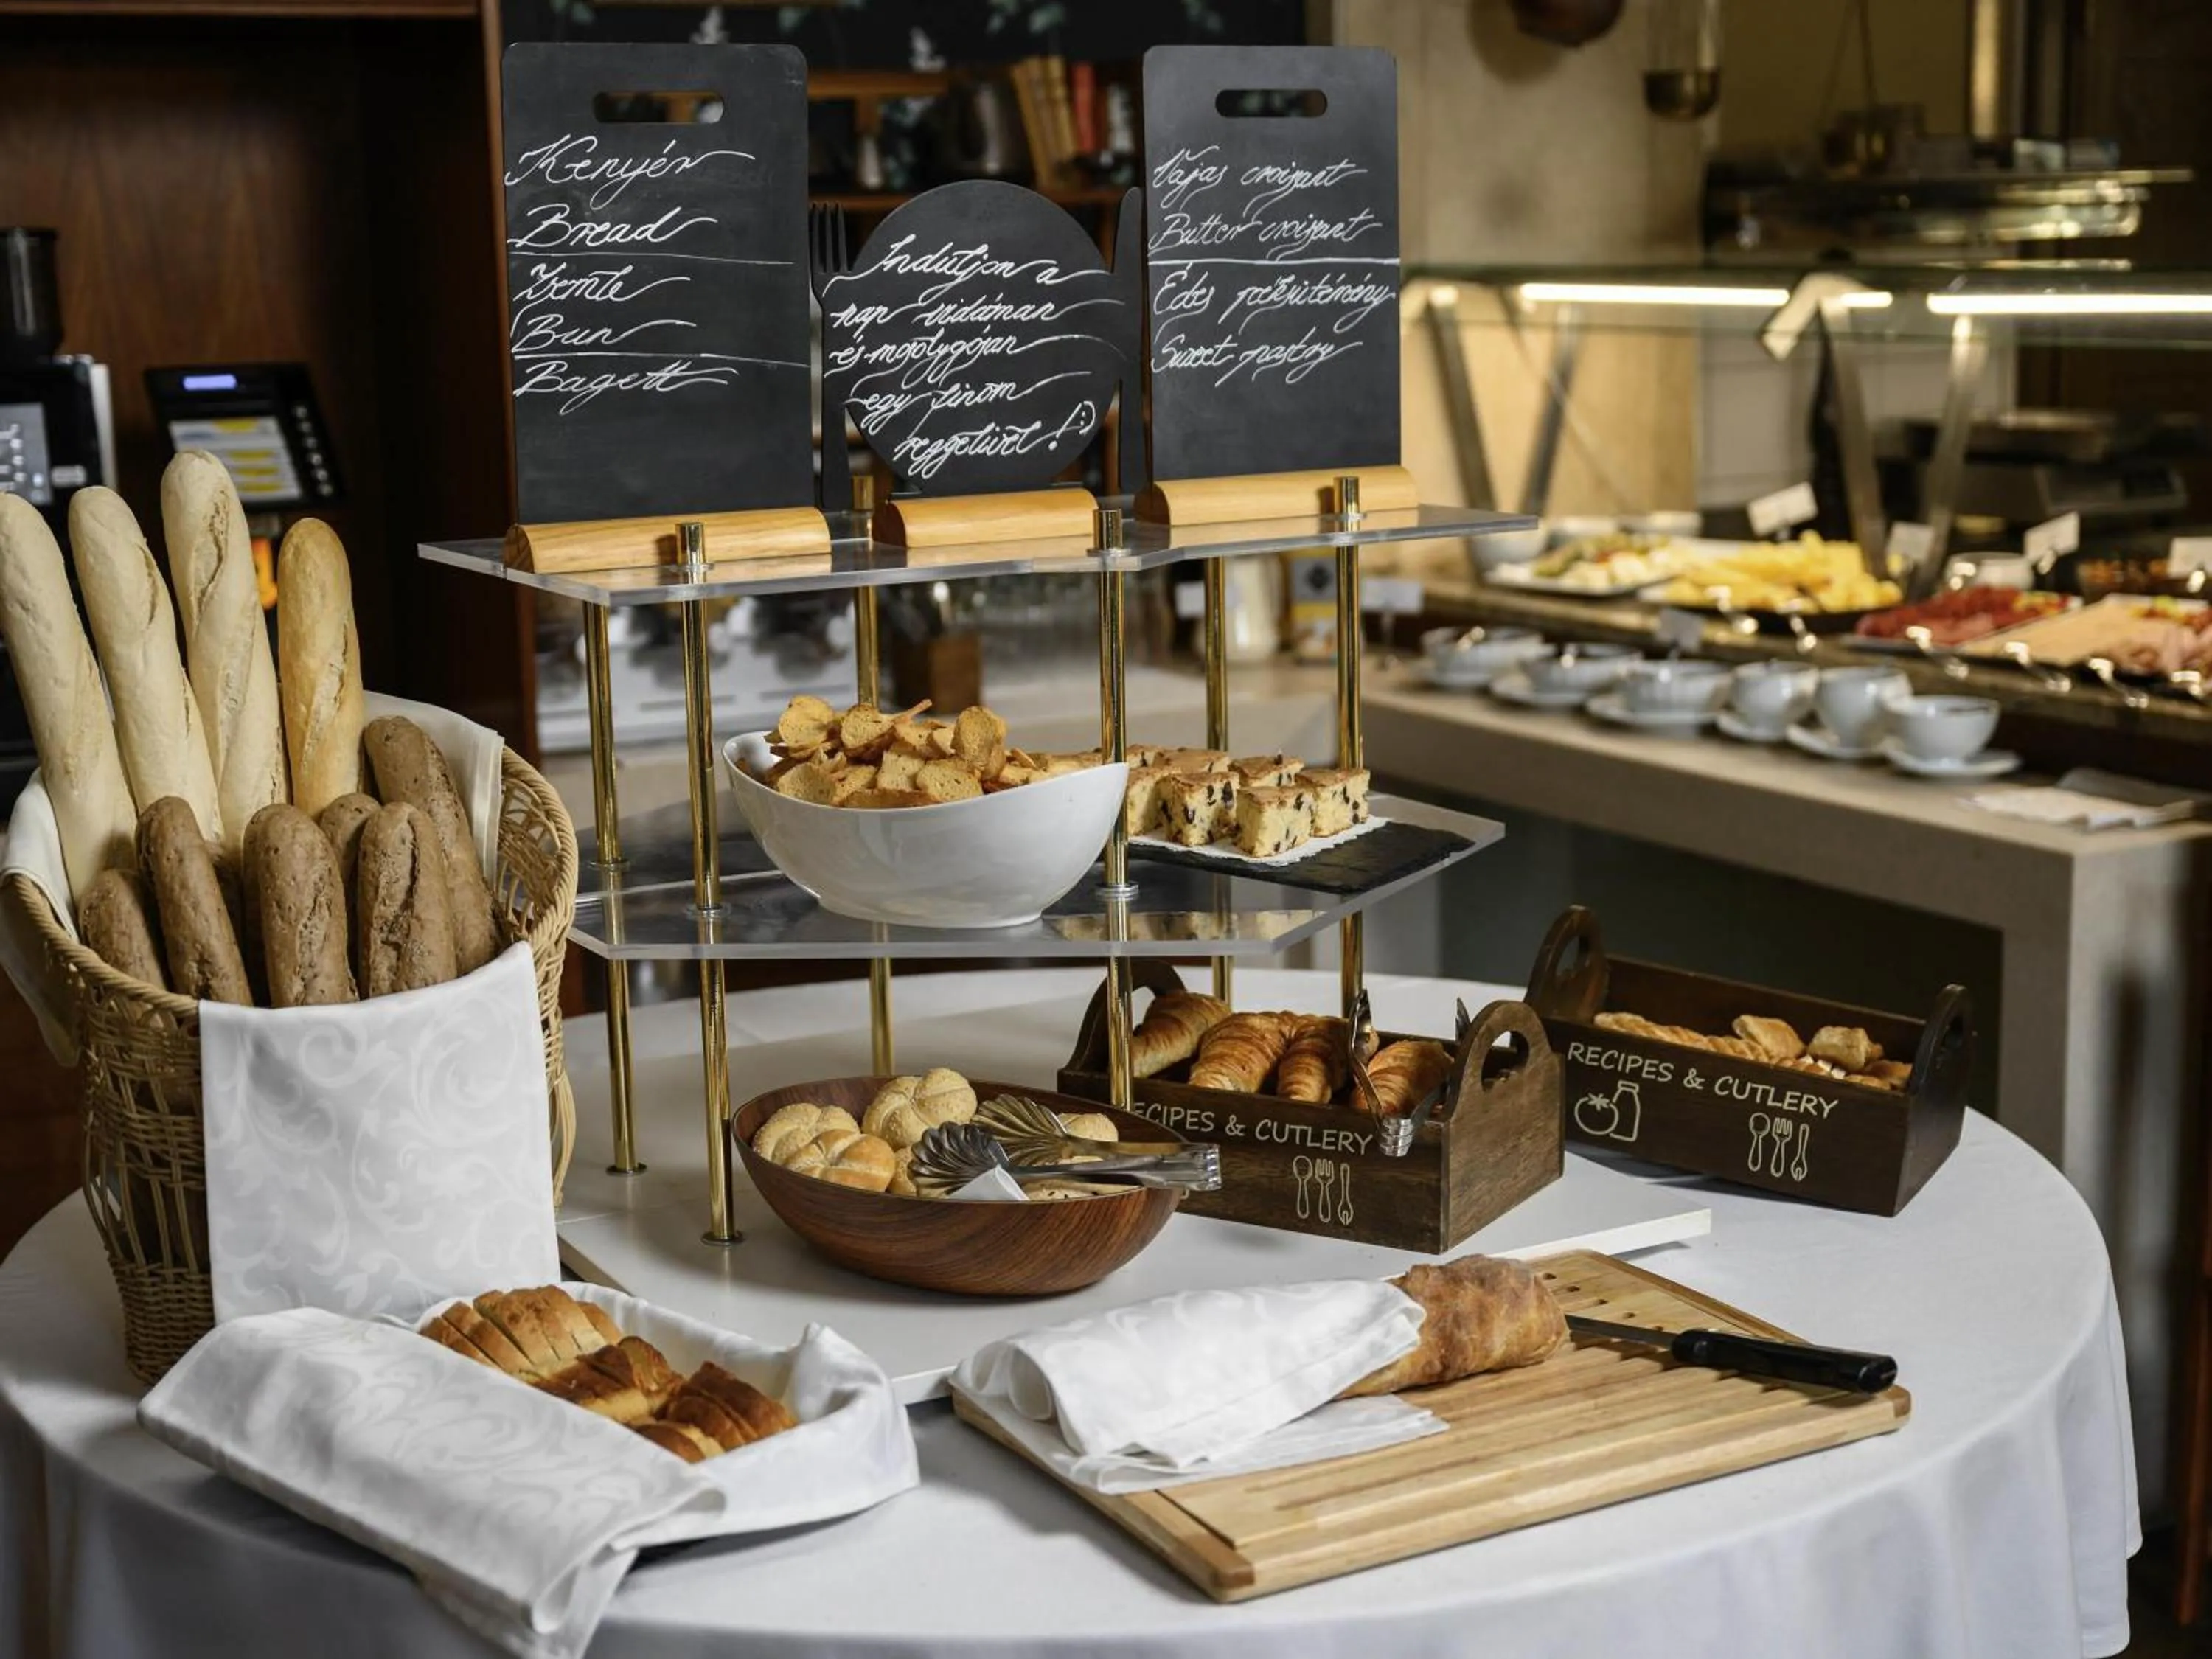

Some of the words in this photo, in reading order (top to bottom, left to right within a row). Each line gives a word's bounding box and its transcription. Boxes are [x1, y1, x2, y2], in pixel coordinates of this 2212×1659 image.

[1152, 145, 1228, 210] Vajas
[507, 204, 719, 248] Bread
[1147, 213, 1263, 257] Butter
[511, 313, 697, 353] Bun
[1568, 1042, 1674, 1083] RECIPES
[1683, 1068, 1704, 1091] &
[1714, 1076, 1838, 1119] CUTLERY
[1133, 1102, 1215, 1133] CIPES
[1225, 1113, 1246, 1137] &
[1255, 1119, 1373, 1155] CUTLERY
